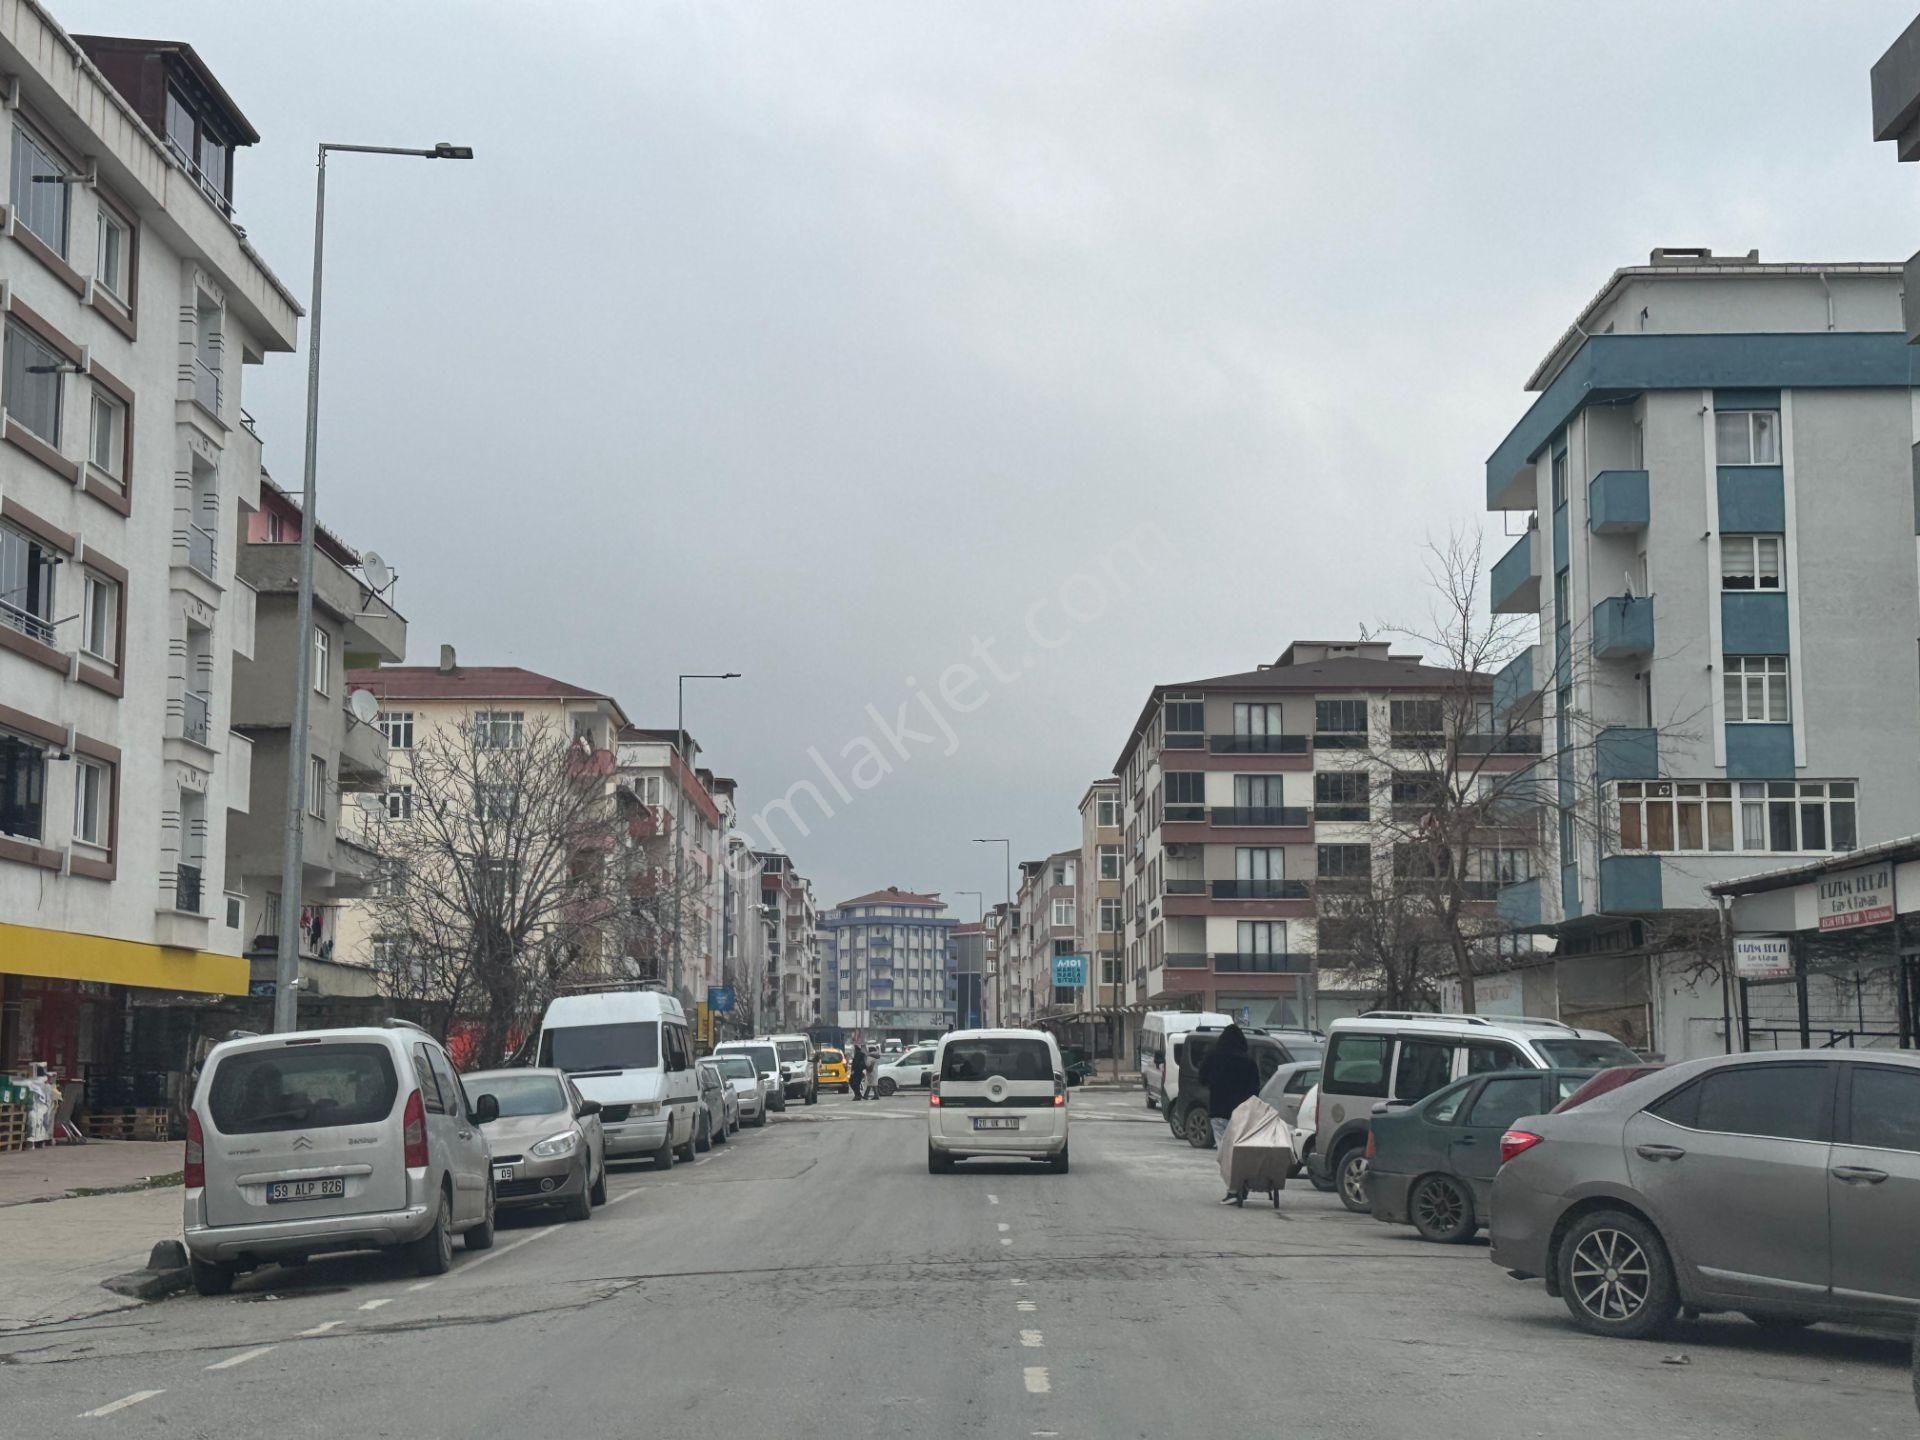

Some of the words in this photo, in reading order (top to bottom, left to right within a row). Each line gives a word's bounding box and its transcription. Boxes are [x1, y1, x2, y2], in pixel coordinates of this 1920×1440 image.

[274, 1185, 289, 1198] 59
[295, 1183, 315, 1196] ALP
[321, 1180, 342, 1194] 826
